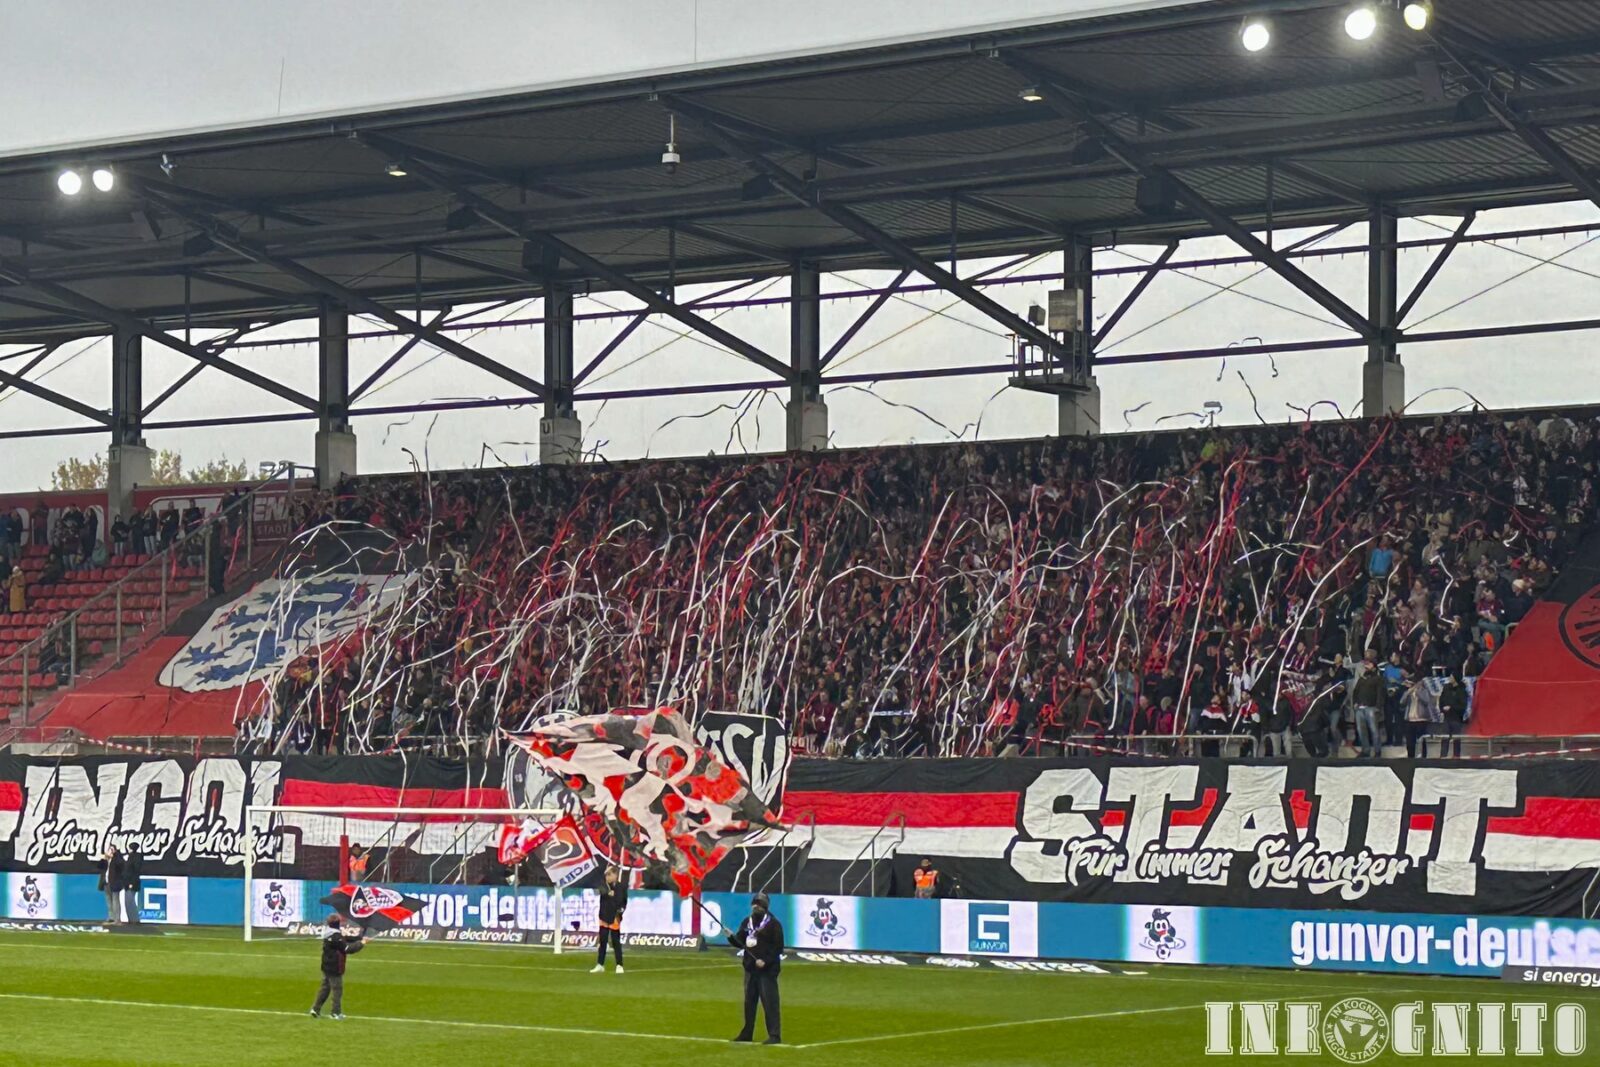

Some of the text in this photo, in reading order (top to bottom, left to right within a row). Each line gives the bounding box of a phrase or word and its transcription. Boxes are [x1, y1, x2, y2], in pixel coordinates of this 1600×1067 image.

[1010, 765, 1518, 896] STADT
[28, 818, 98, 866] Schon
[1140, 844, 1233, 878] immer
[1249, 838, 1410, 901] Schanzer
[389, 927, 430, 940] energy
[446, 928, 523, 942] si electronics
[560, 934, 598, 948] nergy
[629, 933, 698, 948] electronics
[1523, 967, 1600, 988] si energy
